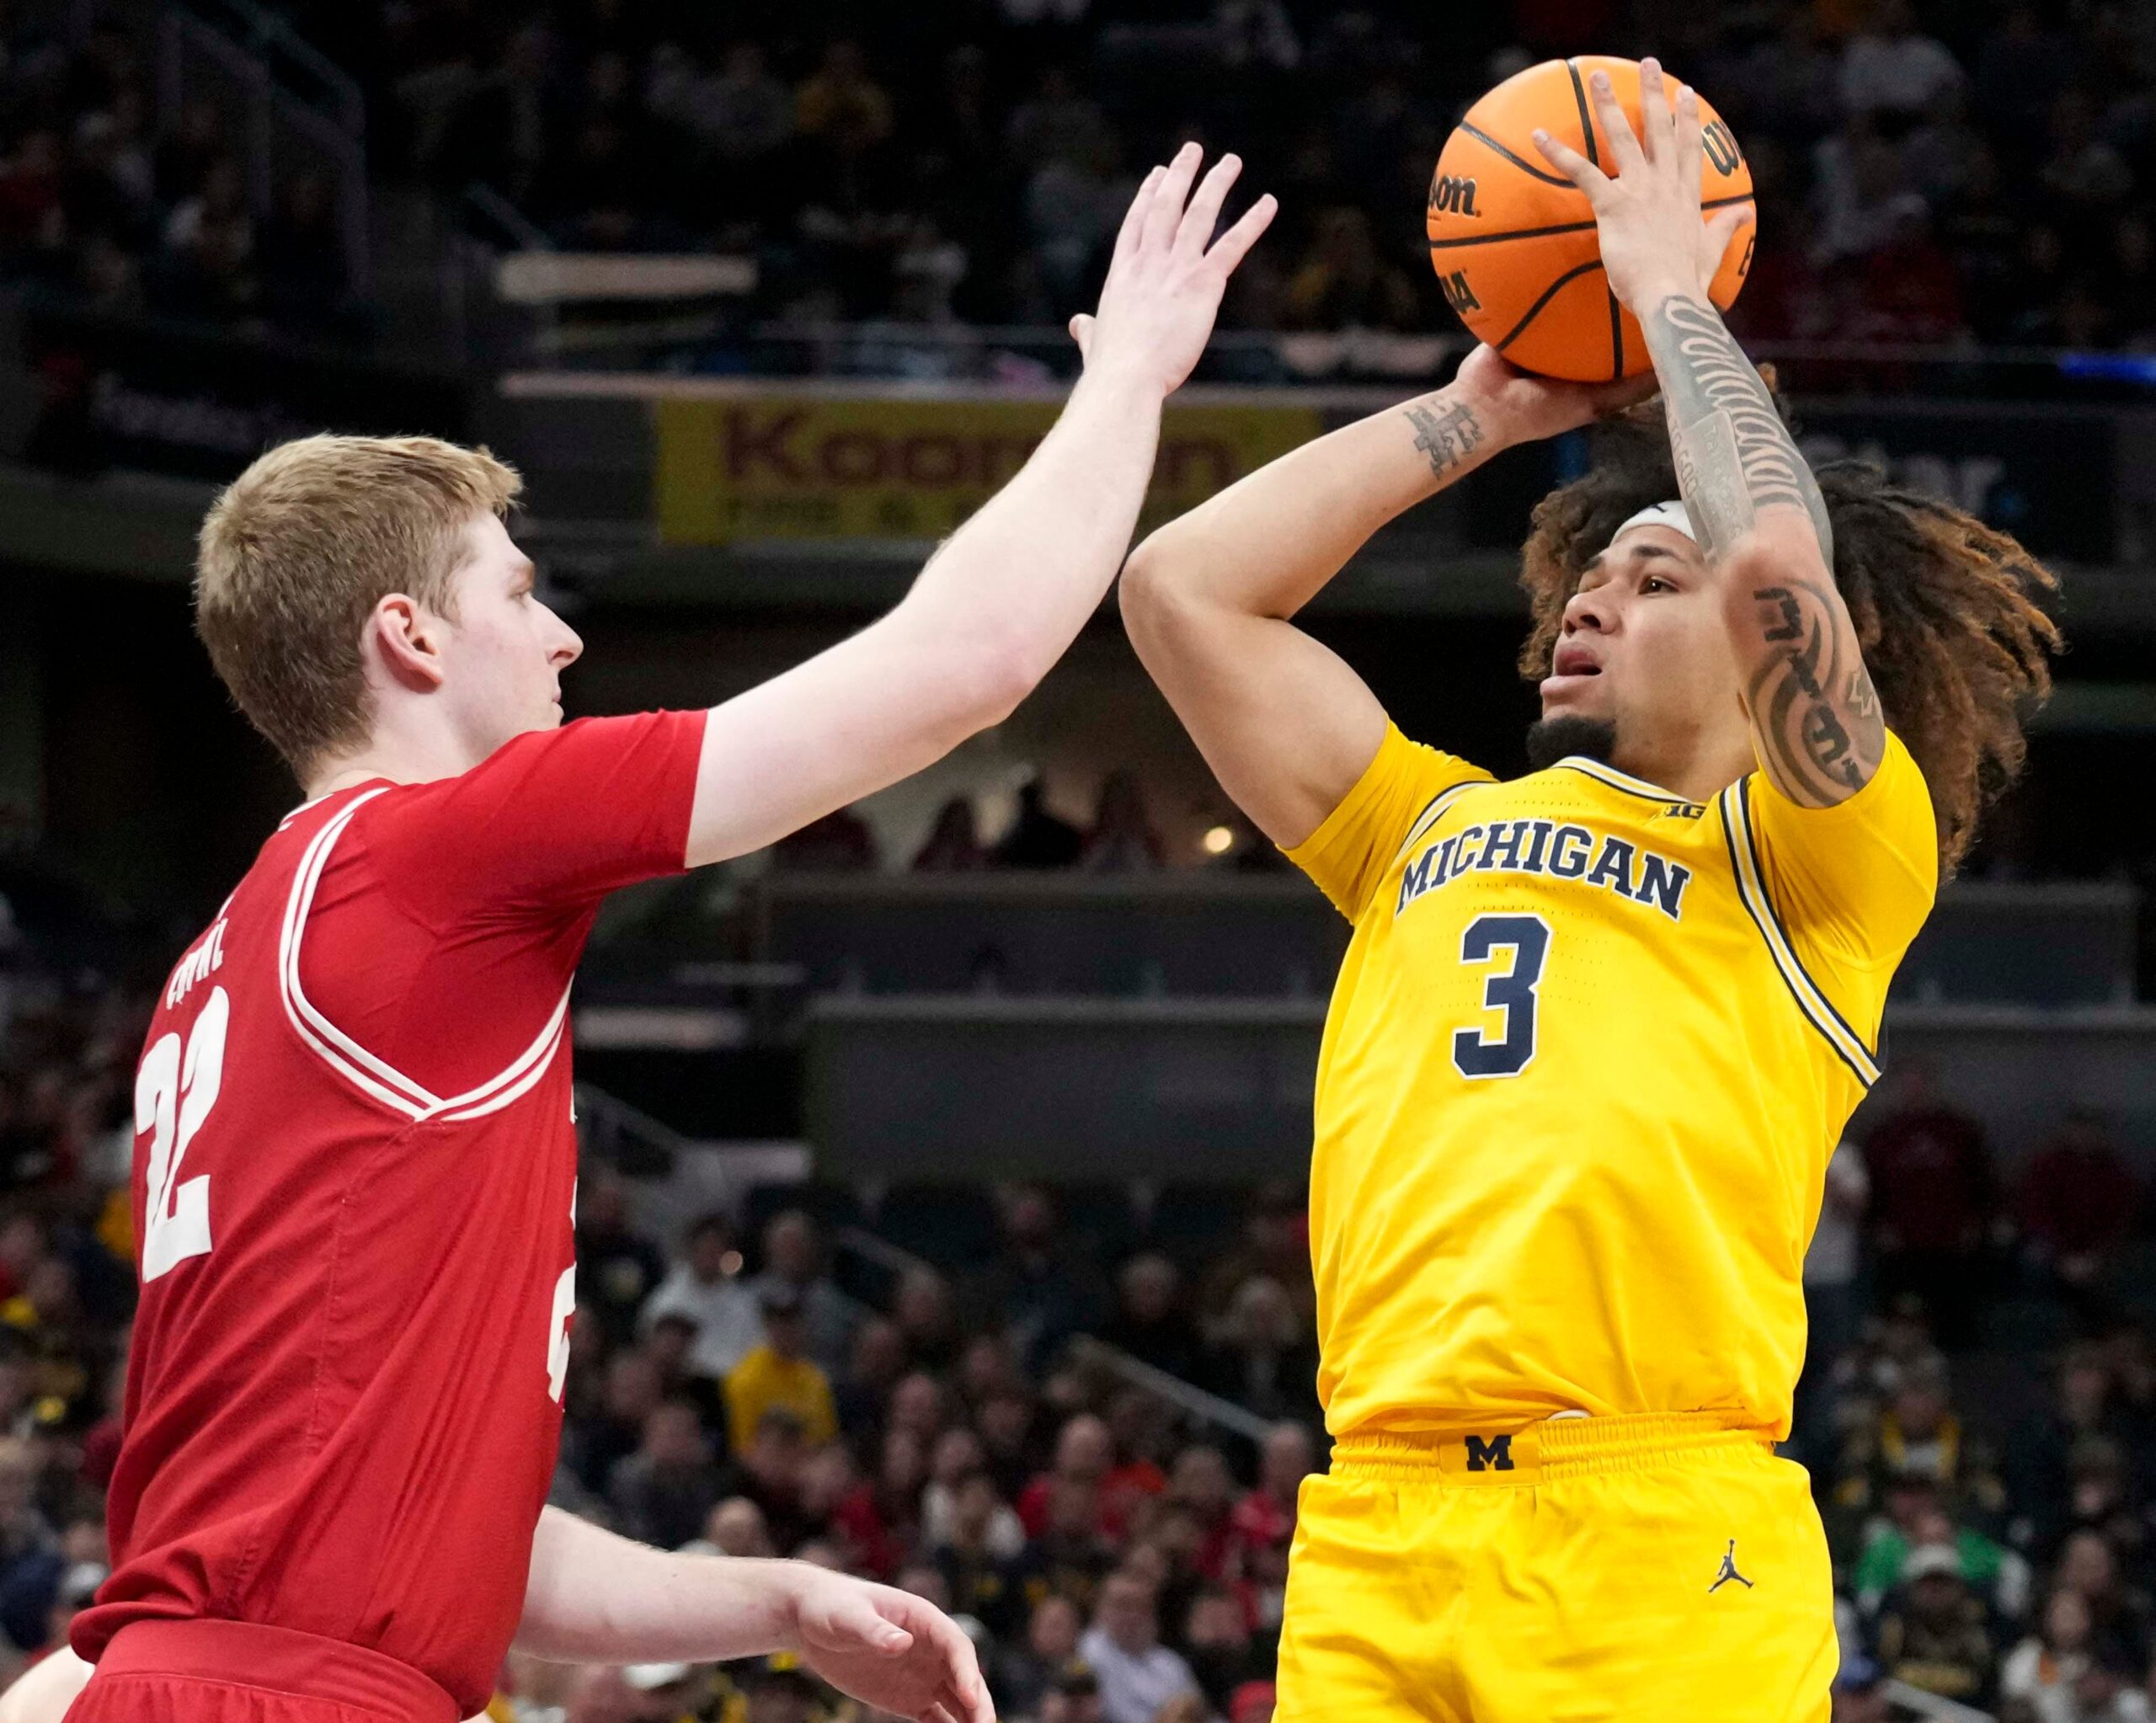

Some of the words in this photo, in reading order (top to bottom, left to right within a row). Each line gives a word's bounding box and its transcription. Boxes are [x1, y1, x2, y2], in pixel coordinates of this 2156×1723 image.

[1396, 818, 1693, 923] MICHIGAN
[1451, 913, 1552, 1080] 3
[1464, 1434, 1514, 1472] M
